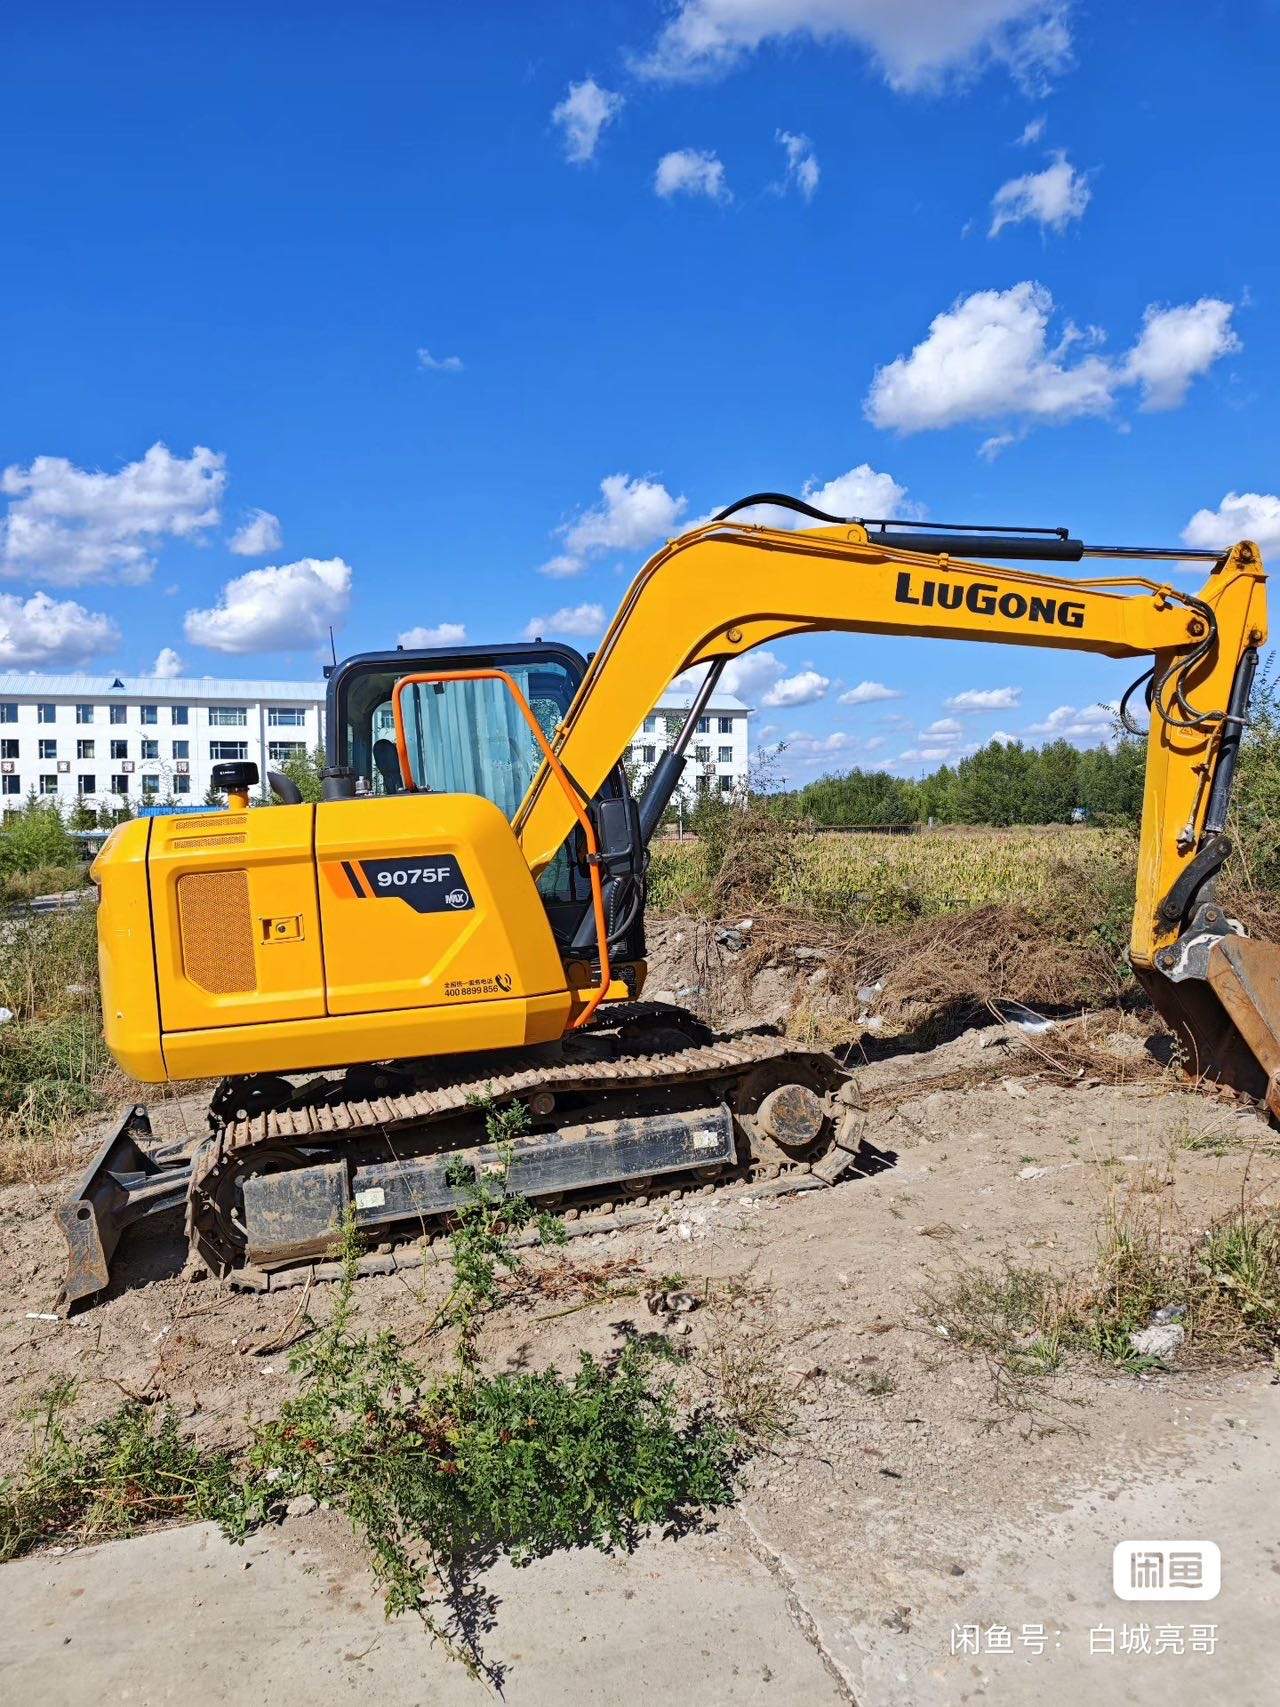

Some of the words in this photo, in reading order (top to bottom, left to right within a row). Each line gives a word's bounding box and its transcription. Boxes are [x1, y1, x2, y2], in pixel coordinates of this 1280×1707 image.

[377, 867, 451, 887] 9075F
[445, 988, 460, 997] 400
[461, 986, 482, 996] 8899
[483, 984, 499, 993] 856
